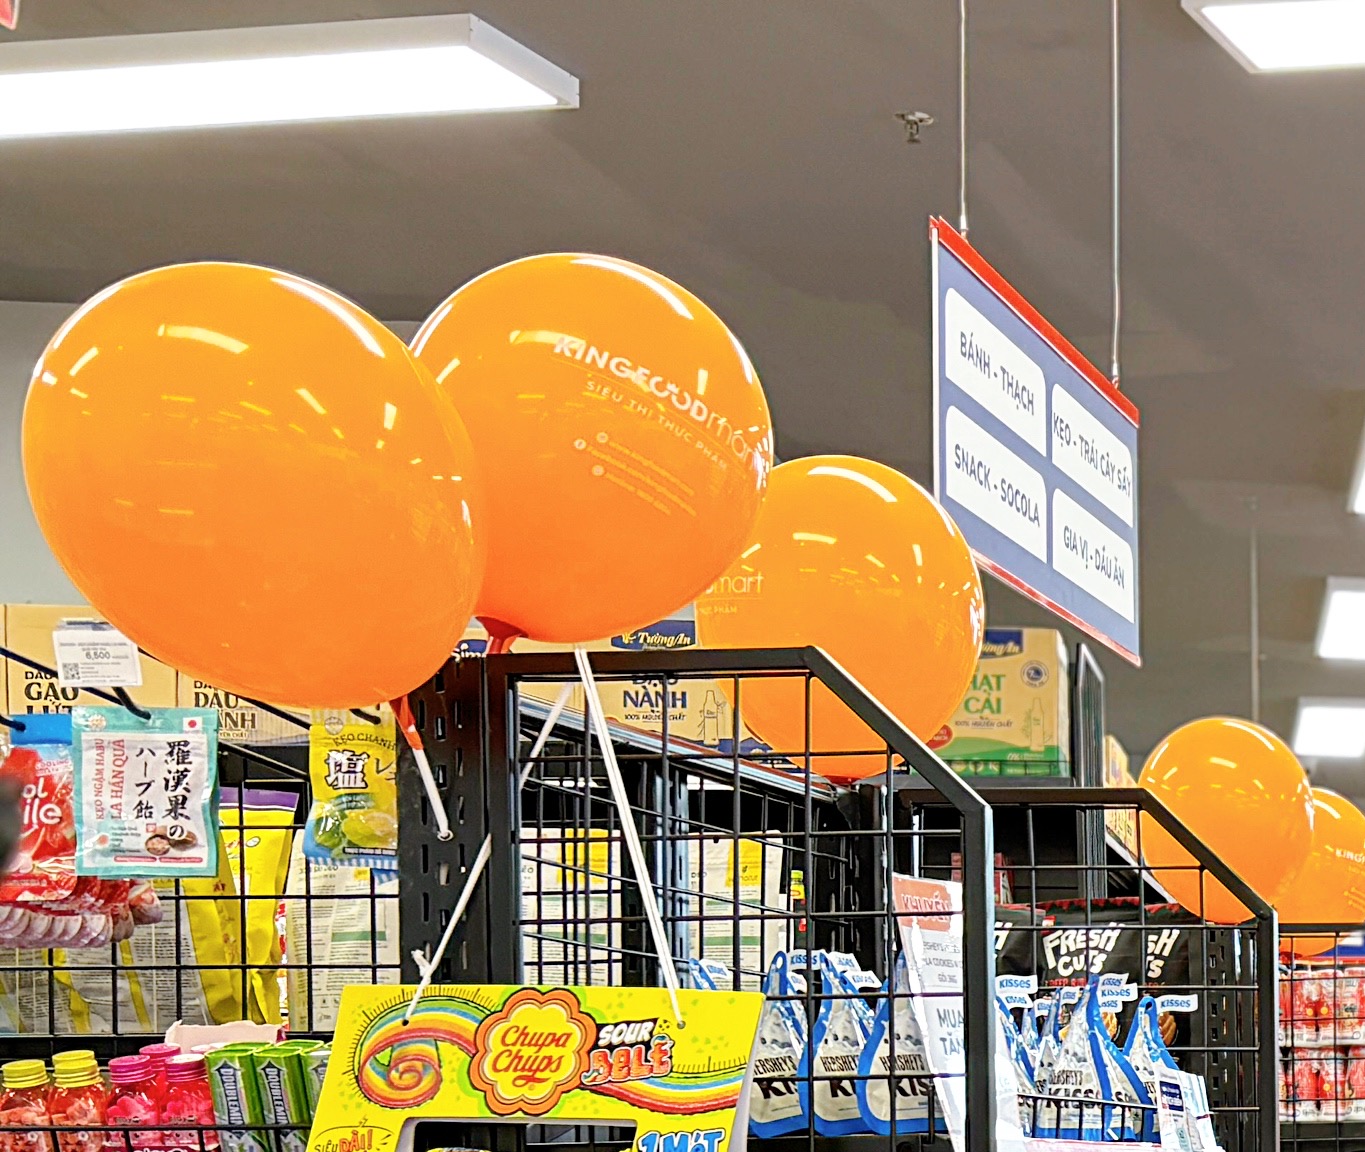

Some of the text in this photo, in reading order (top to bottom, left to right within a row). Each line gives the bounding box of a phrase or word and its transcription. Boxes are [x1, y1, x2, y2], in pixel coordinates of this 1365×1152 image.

[959, 332, 990, 379] BÁNH
[1000, 364, 1035, 416] THẠCH
[1053, 411, 1072, 446] KẸO
[1079, 434, 1099, 470] TRÁI
[1100, 451, 1116, 484] CÂY
[954, 444, 991, 492] SNACK
[1000, 476, 1041, 528] SOCOLA
[1063, 525, 1079, 552] GIA
[1079, 542, 1089, 570] VỊ
[500, 1024, 574, 1057] Chupa
[597, 1019, 655, 1047] SOUR
[491, 1044, 564, 1087] Chups
